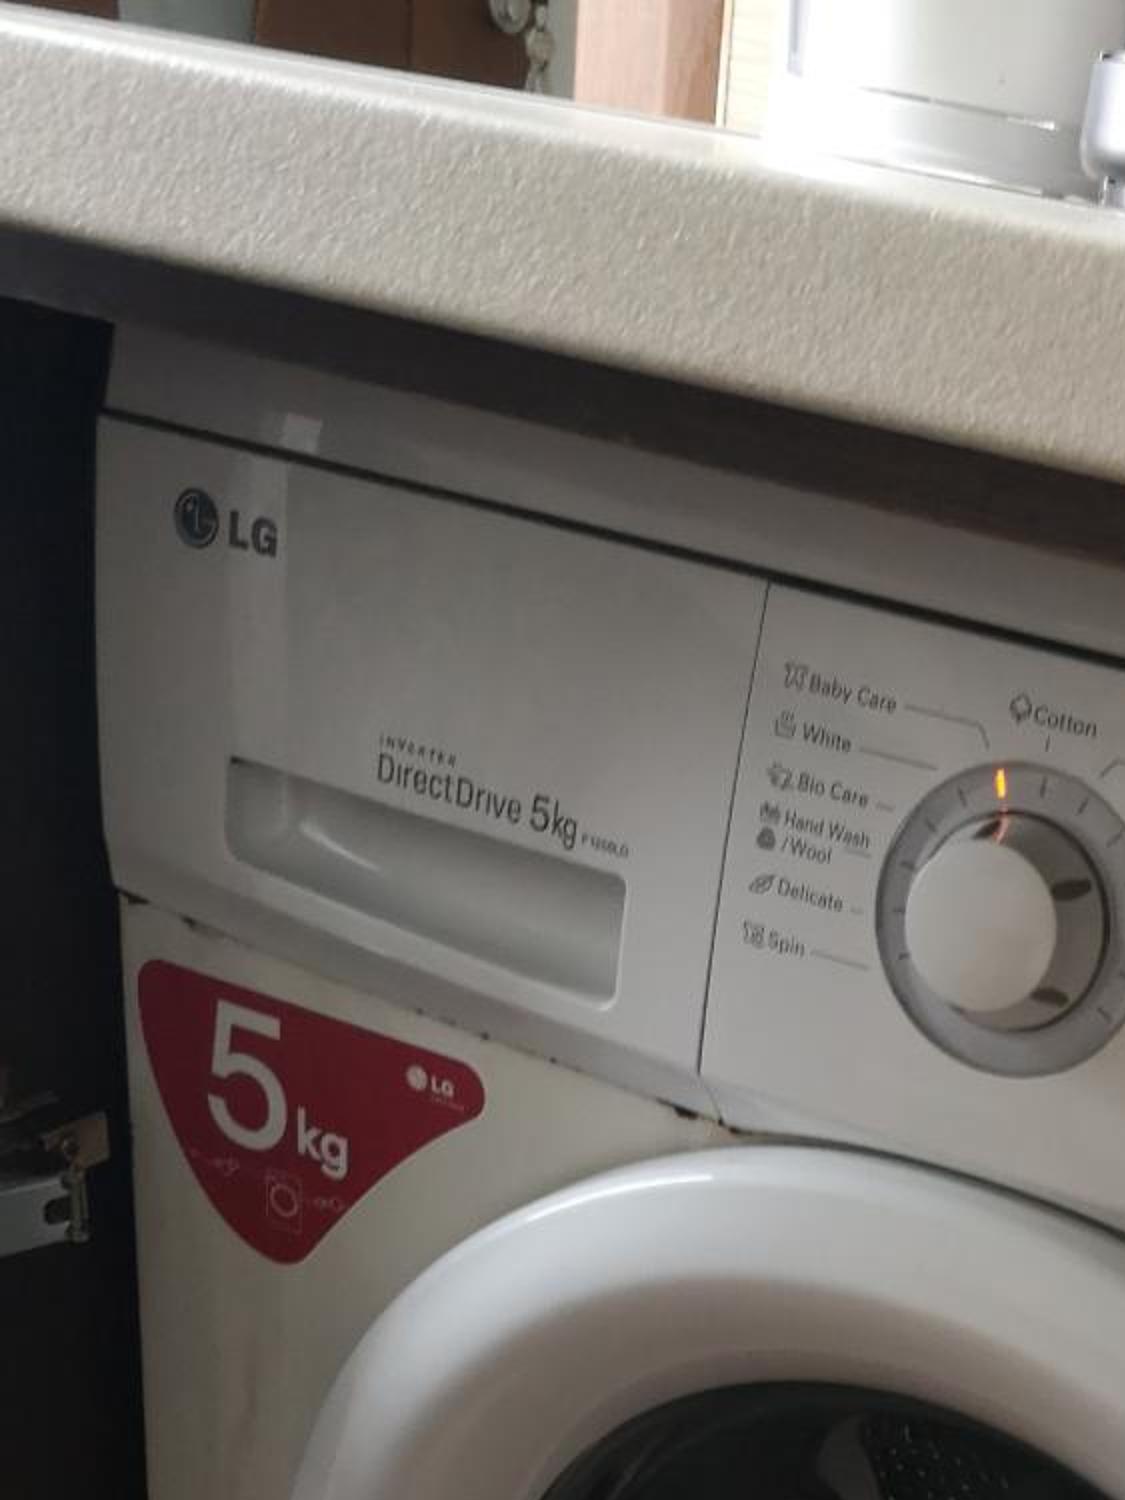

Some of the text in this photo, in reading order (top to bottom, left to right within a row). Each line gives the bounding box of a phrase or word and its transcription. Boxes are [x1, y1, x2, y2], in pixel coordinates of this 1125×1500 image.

[229, 510, 278, 557] LG
[809, 672, 897, 714] Baby Care
[802, 720, 852, 753] White
[1033, 705, 1098, 738] Cotton
[379, 733, 457, 768] INVERTER
[798, 773, 870, 808] Bio Care
[529, 794, 579, 850] 5kg
[784, 803, 871, 849] Hand Wash
[777, 876, 844, 913] Delicate
[767, 930, 806, 957] Spin
[430, 1075, 455, 1098] LG
